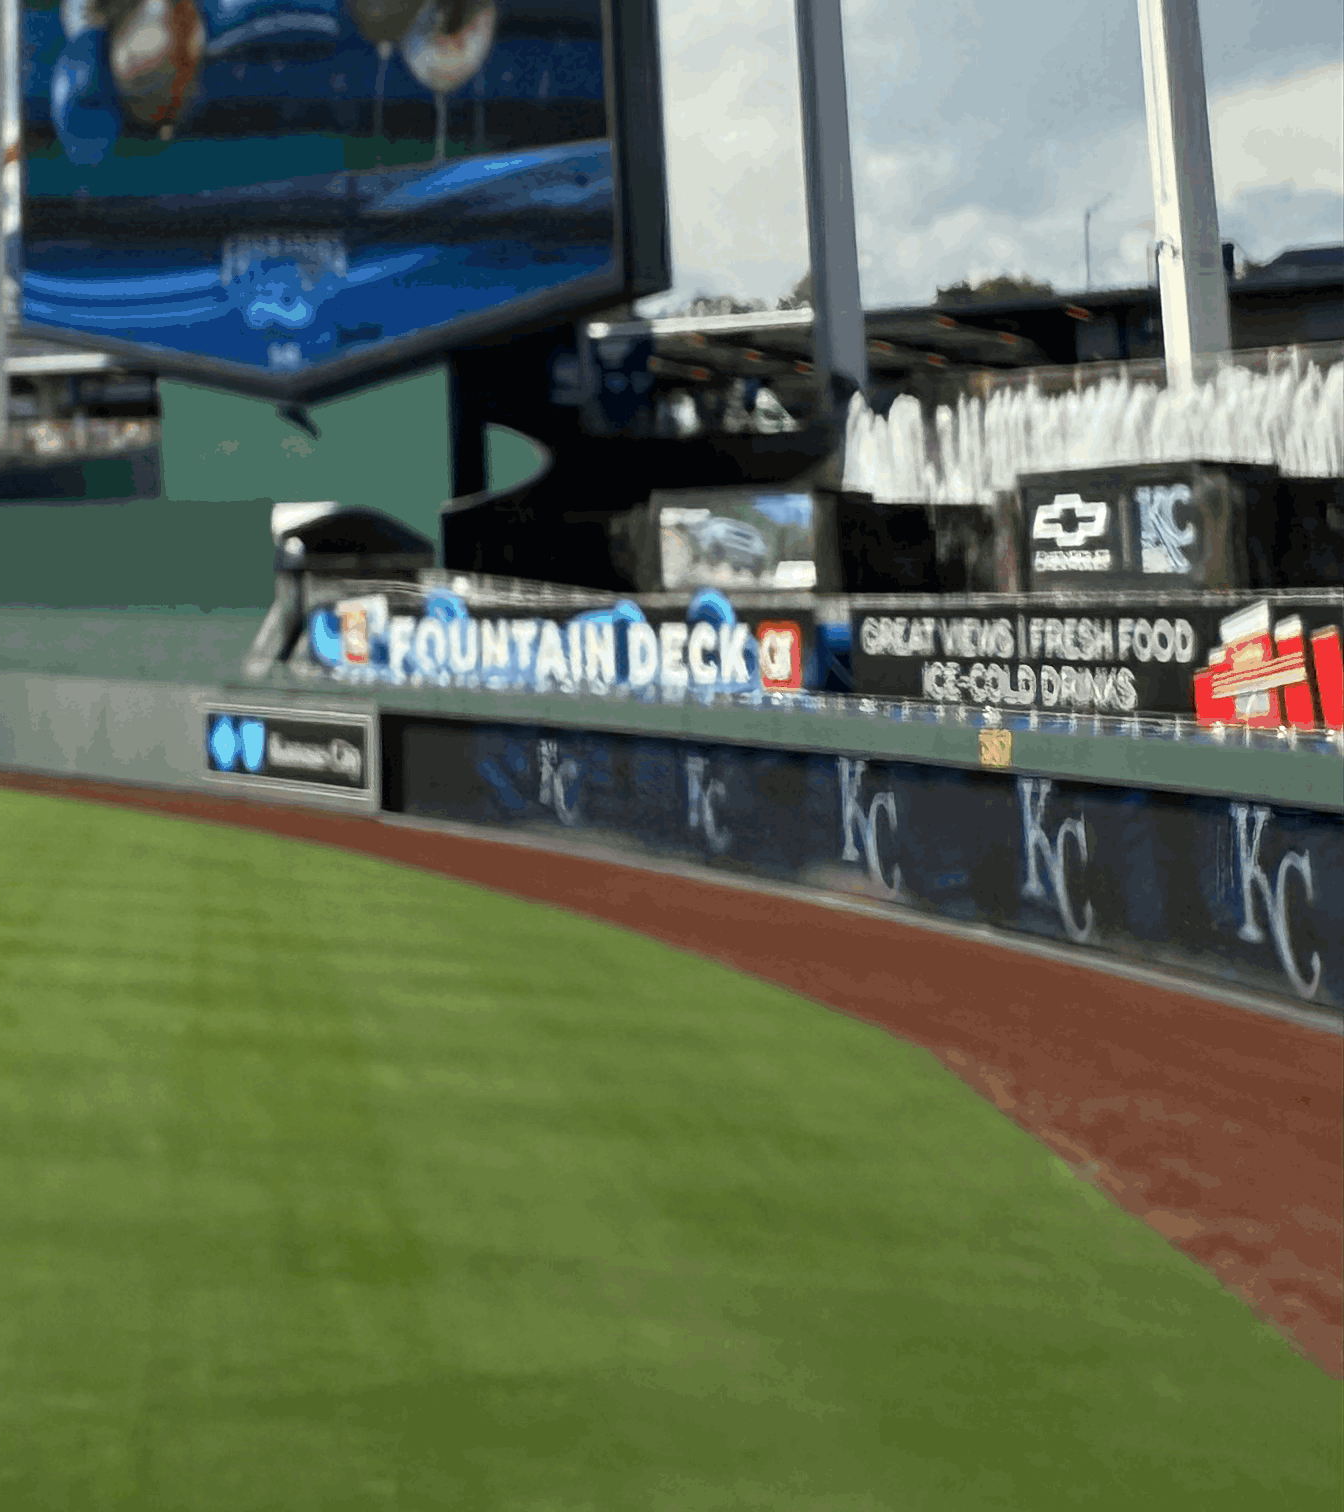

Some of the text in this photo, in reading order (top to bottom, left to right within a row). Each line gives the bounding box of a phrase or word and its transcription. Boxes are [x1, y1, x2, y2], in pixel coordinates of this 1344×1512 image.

[390, 616, 614, 689] FOUNTAIN
[628, 622, 751, 685] DECK
[1030, 617, 1115, 661] FRESH
[1118, 618, 1194, 664] FOOD
[837, 756, 902, 898] KC
[1020, 777, 1093, 942] KC
[1232, 804, 1322, 998] KC
